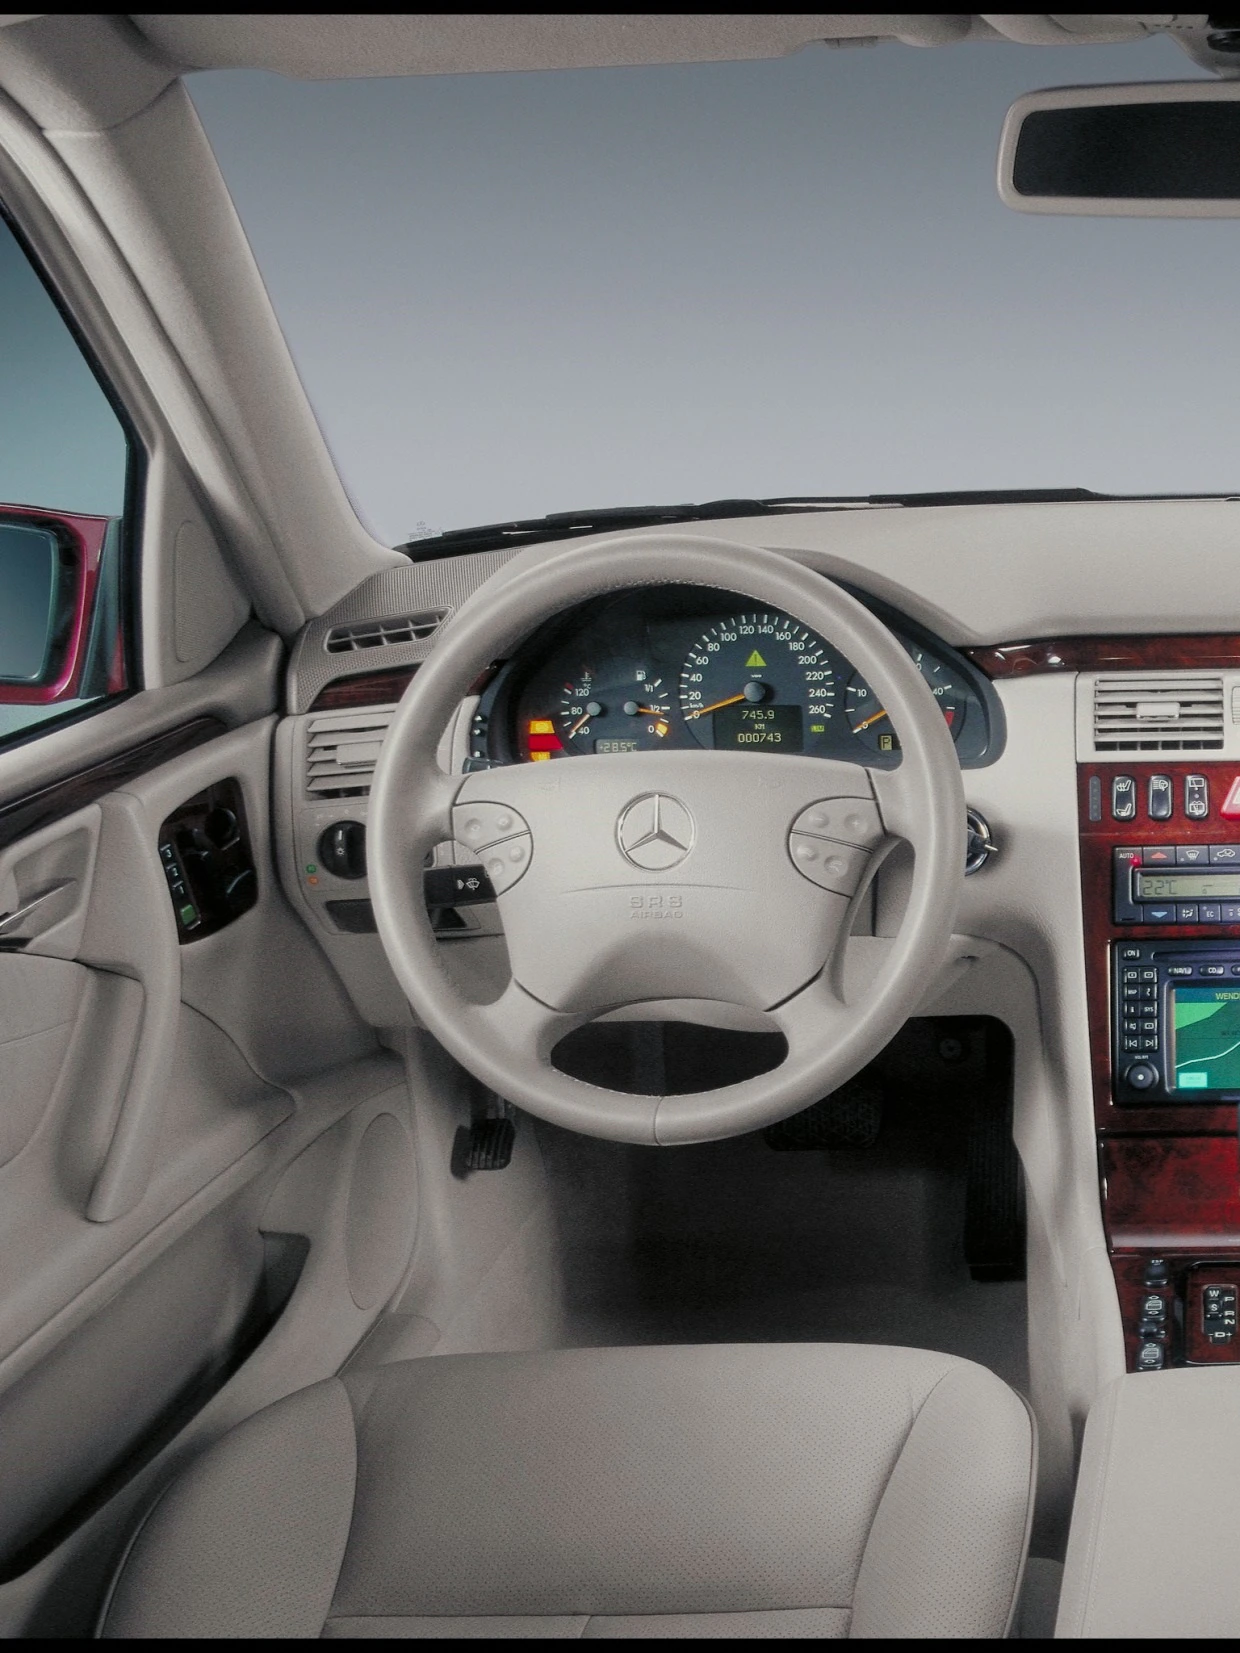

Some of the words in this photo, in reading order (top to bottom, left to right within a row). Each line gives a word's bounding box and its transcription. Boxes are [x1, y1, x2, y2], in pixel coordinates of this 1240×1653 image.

[739, 625, 755, 634] 120
[758, 625, 774, 634] 140
[720, 632, 737, 642] 100
[775, 631, 792, 641] 160
[707, 643, 720, 651] 80
[789, 641, 805, 651] 180
[695, 656, 709, 665] 60
[798, 655, 817, 665] 200
[689, 673, 703, 682] 40
[805, 671, 824, 681] 220
[575, 688, 590, 697] 120
[644, 683, 654, 693] 1/1
[808, 688, 827, 697] 240
[857, 688, 867, 697] 10
[932, 687, 944, 695] 40
[688, 691, 702, 700] 20
[571, 706, 583, 715] 80
[650, 704, 660, 713] 1/2
[808, 705, 826, 714] 260
[693, 710, 701, 719] 0
[741, 710, 775, 720] 745.9
[578, 726, 590, 735] 40
[647, 724, 655, 734] 0
[737, 732, 782, 743] 000743
[882, 736, 891, 749] P
[1142, 879, 1178, 896] 22°C
[629, 895, 683, 909] SRS
[629, 910, 684, 920] AIRBAG
[1206, 910, 1215, 918] EC
[1127, 949, 1136, 957] ON
[1211, 1303, 1218, 1312] S
